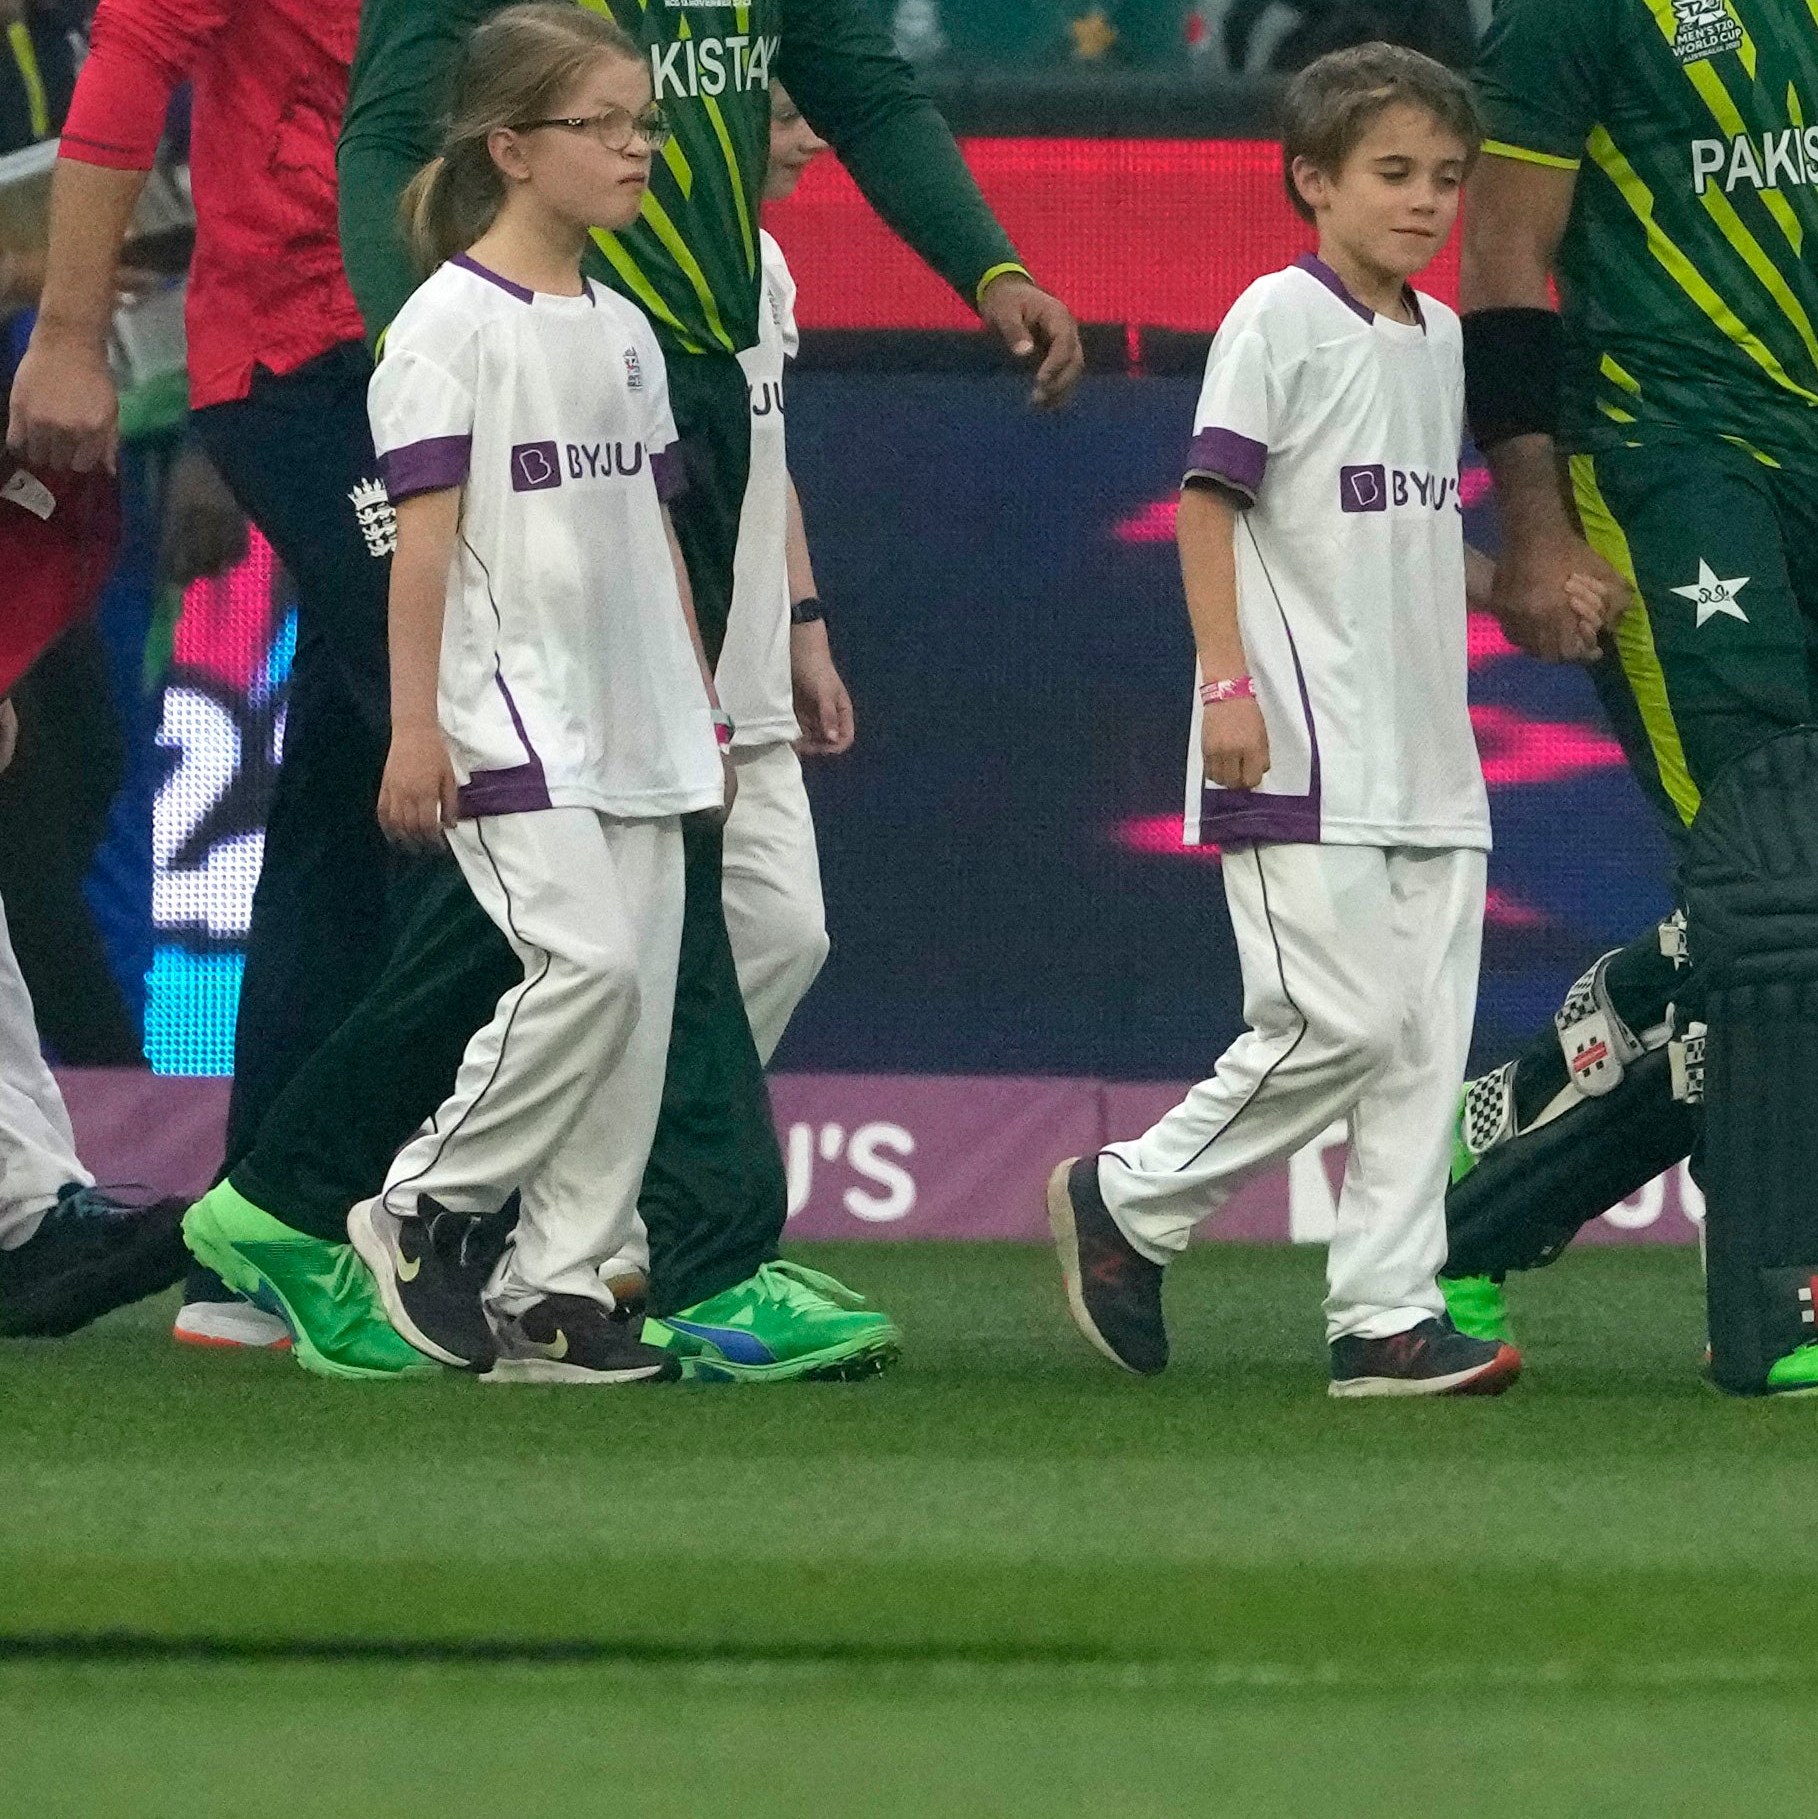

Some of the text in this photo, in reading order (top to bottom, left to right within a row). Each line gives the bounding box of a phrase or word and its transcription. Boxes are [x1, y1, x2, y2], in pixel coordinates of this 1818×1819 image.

[1672, 27, 1742, 57] WORLD CUP
[1676, 26, 1714, 44] MEN'S
